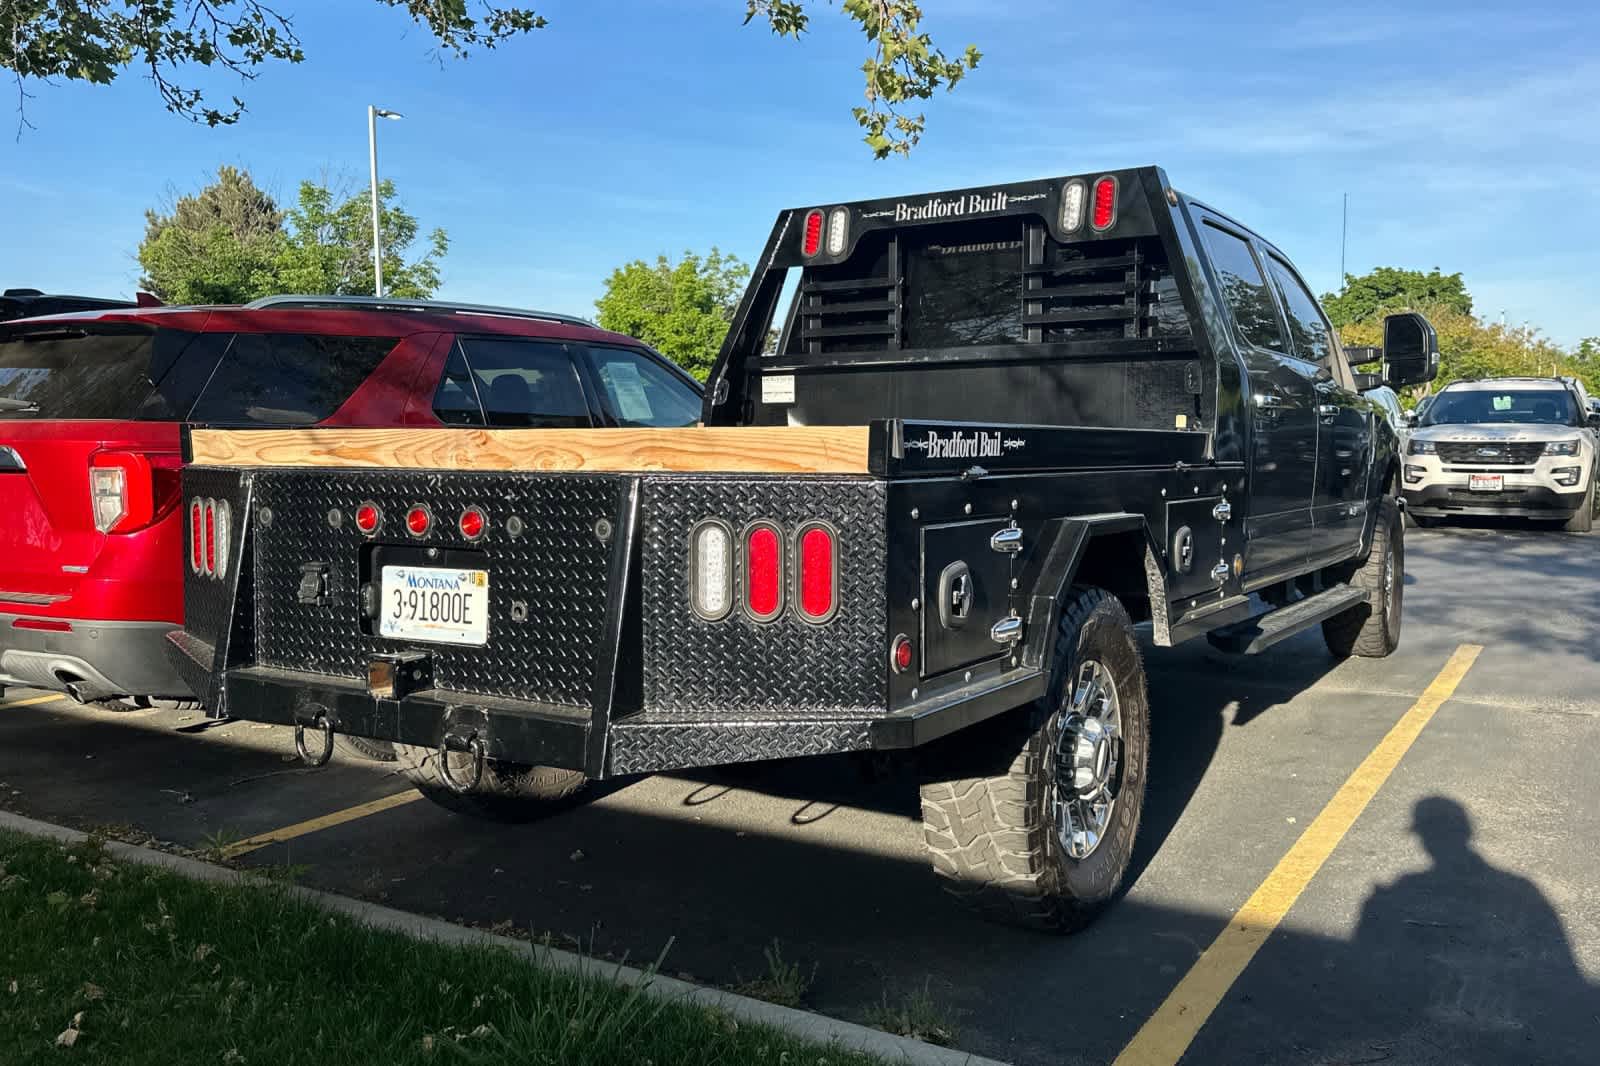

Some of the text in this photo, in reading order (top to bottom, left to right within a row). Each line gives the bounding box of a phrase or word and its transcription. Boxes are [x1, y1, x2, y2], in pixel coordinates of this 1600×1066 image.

[895, 192, 1008, 222] Bradford Built
[927, 430, 978, 458] Bradford
[406, 573, 461, 590] MONTANA
